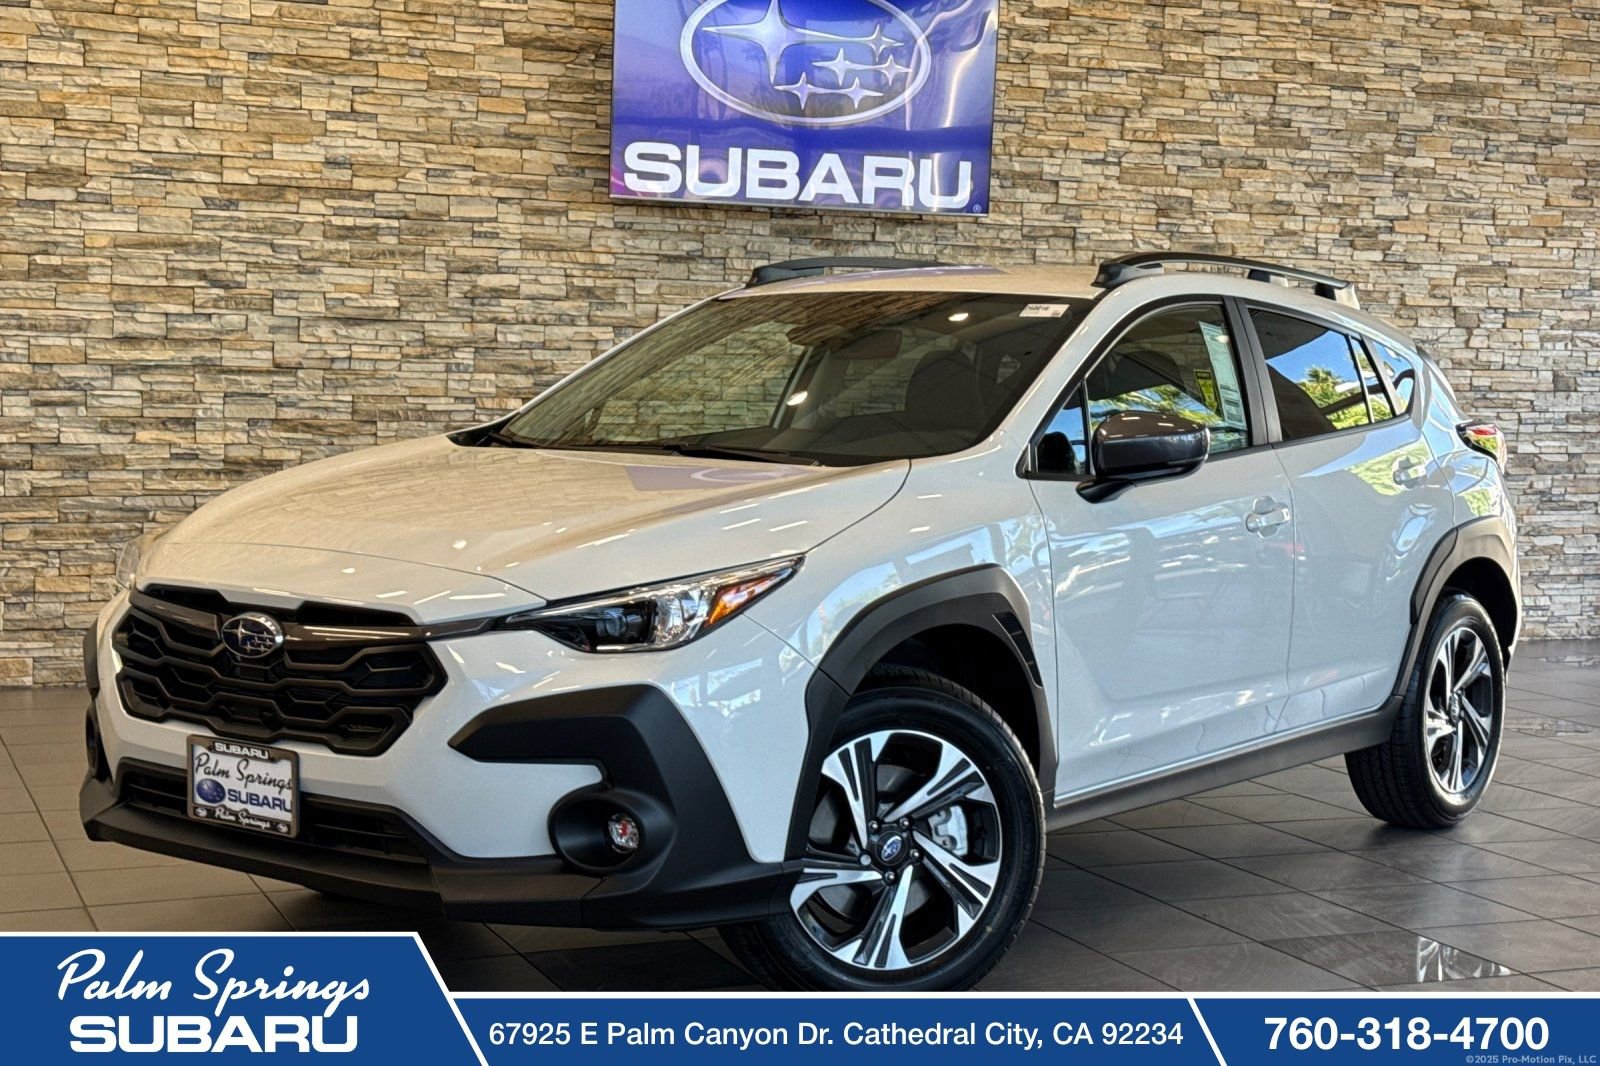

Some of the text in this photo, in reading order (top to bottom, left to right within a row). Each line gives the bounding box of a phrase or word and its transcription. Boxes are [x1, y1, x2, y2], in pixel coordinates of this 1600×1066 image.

[624, 141, 971, 209] SUBARU
[214, 742, 269, 759] SUBARU
[195, 752, 292, 795] Palm Springs
[227, 789, 292, 812] SUBARU
